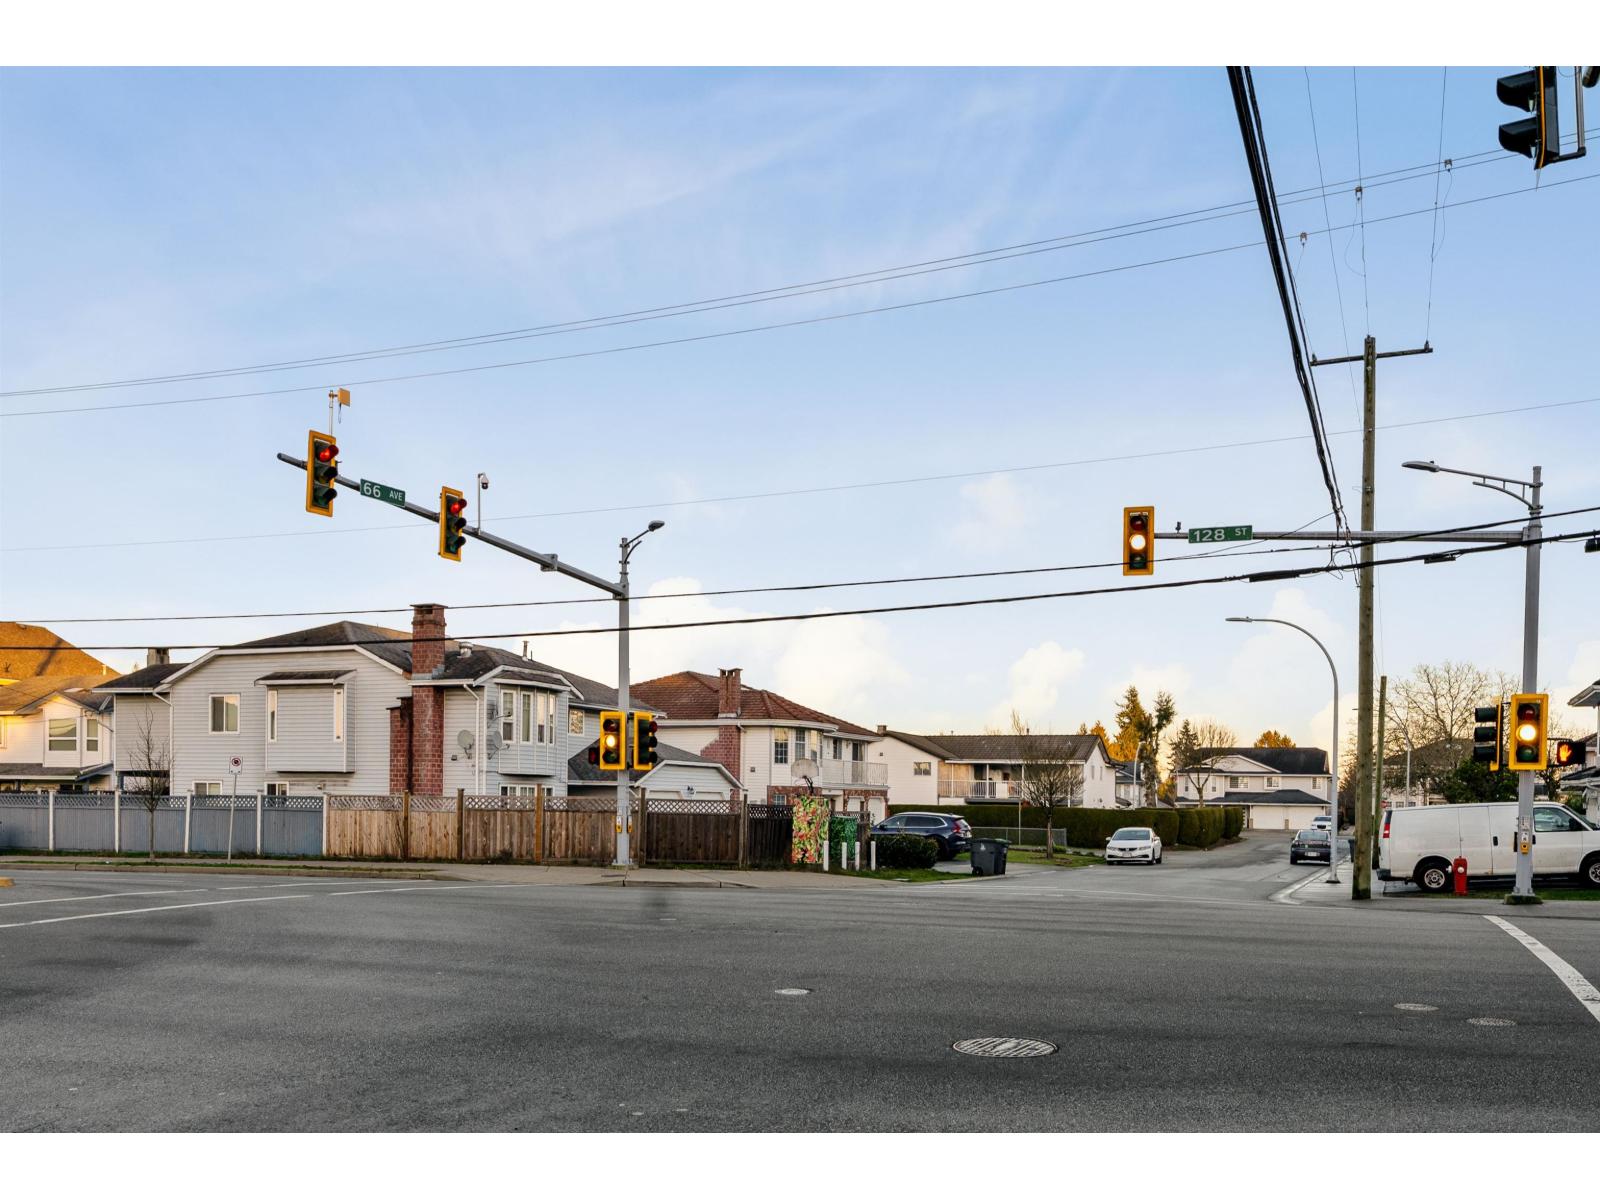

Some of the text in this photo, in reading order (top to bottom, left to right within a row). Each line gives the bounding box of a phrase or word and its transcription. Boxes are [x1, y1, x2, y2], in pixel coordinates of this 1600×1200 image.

[363, 482, 403, 501] 66 AVE
[1193, 528, 1247, 542] 128 ST
